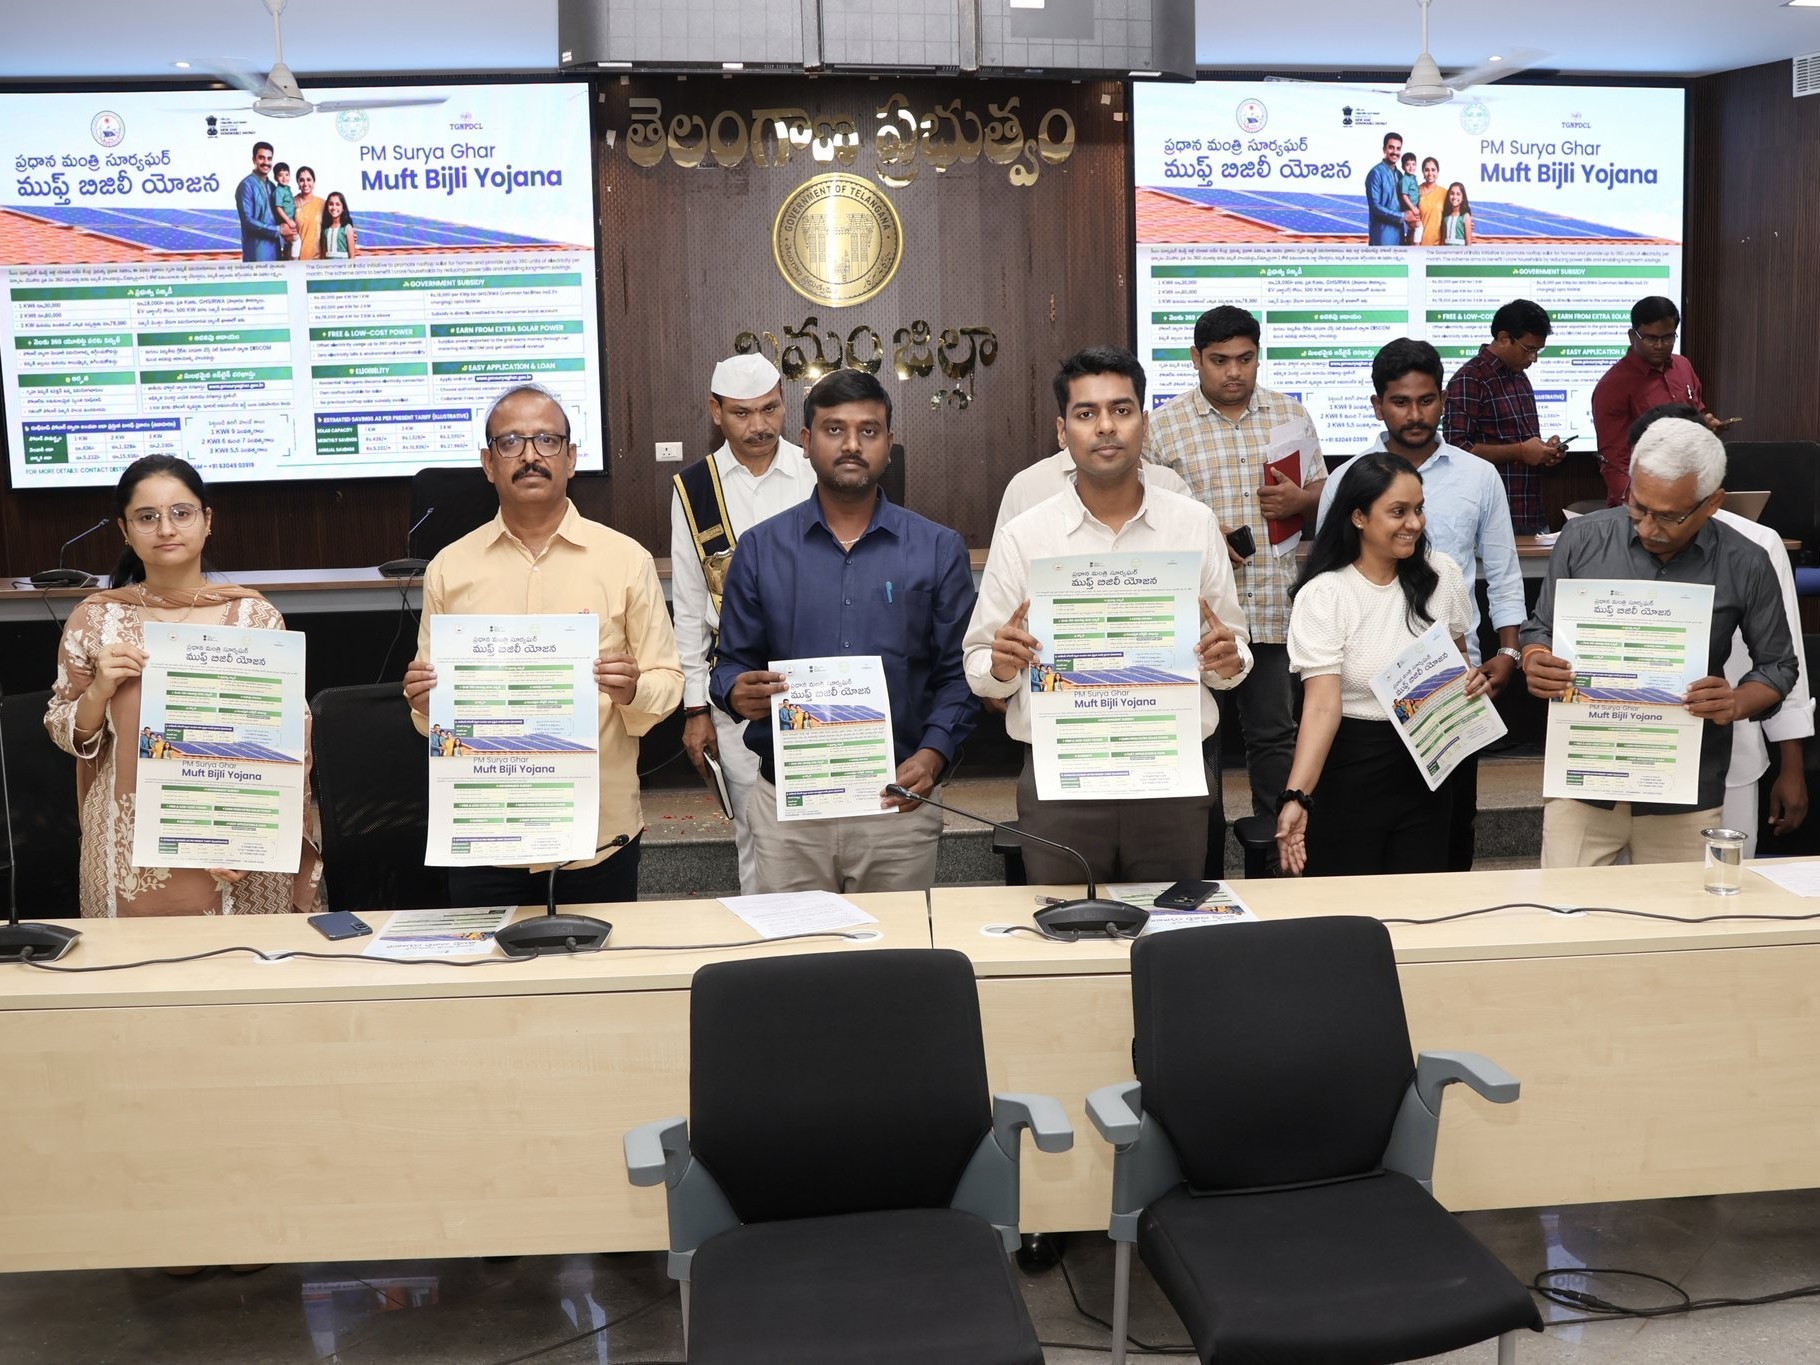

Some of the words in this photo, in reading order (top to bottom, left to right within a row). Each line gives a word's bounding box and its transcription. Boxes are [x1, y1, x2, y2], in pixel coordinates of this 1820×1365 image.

[626, 97, 860, 168] తెలంగాణ
[875, 92, 1075, 188] ప్రభుత్వం
[1164, 138, 1201, 156] ప్రధాన
[1207, 138, 1242, 155] మంత్రి
[1248, 136, 1307, 157] సూర్యఘర్
[1481, 140, 1504, 154] PM
[1510, 140, 1555, 160] Surya
[1561, 140, 1600, 156] Ghar
[16, 154, 56, 172] ప్రధాన
[62, 154, 100, 171] మంత్రి
[106, 150, 170, 172] సూర్యఘర్
[360, 146, 386, 161] PM
[394, 146, 444, 165] Surya
[451, 143, 495, 158] Ghar
[362, 167, 418, 190] Muft
[426, 165, 467, 195] Bijli
[474, 164, 562, 194] Yojana
[1164, 156, 1212, 187] ముఫ్త్
[1221, 155, 1270, 178] బిజిలీ
[1280, 160, 1351, 179] యోజన
[1481, 162, 1530, 182] Muft
[1538, 162, 1574, 190] Bijli
[1581, 162, 1657, 190] Yojana
[17, 172, 71, 206] ముఫ్త్
[79, 170, 133, 196] బిజిలీ
[142, 173, 220, 194] యోజన
[784, 186, 830, 232] GOVERNMENT
[835, 185, 846, 193] OF
[850, 187, 891, 231] TELANGANA
[351, 329, 388, 337] LOW-COST
[1074, 690, 1085, 698] PM
[1088, 690, 1109, 699] Surya
[1111, 689, 1130, 697] Ghar
[1074, 698, 1097, 708] Muft
[1100, 698, 1118, 710] Bijli
[1121, 698, 1156, 709] Yojana
[1588, 710, 1610, 719] Muft
[1612, 711, 1628, 721] Bijli
[1630, 712, 1662, 722] Yojana
[1601, 704, 1621, 712] Surya
[195, 760, 217, 769] Surya
[474, 764, 496, 773] Muft
[500, 764, 517, 775] Bijli
[520, 764, 555, 775] Yojana
[487, 756, 508, 765] Surya
[182, 768, 204, 777] Muft
[208, 769, 224, 780] Bijli
[227, 770, 262, 781] Yojana
